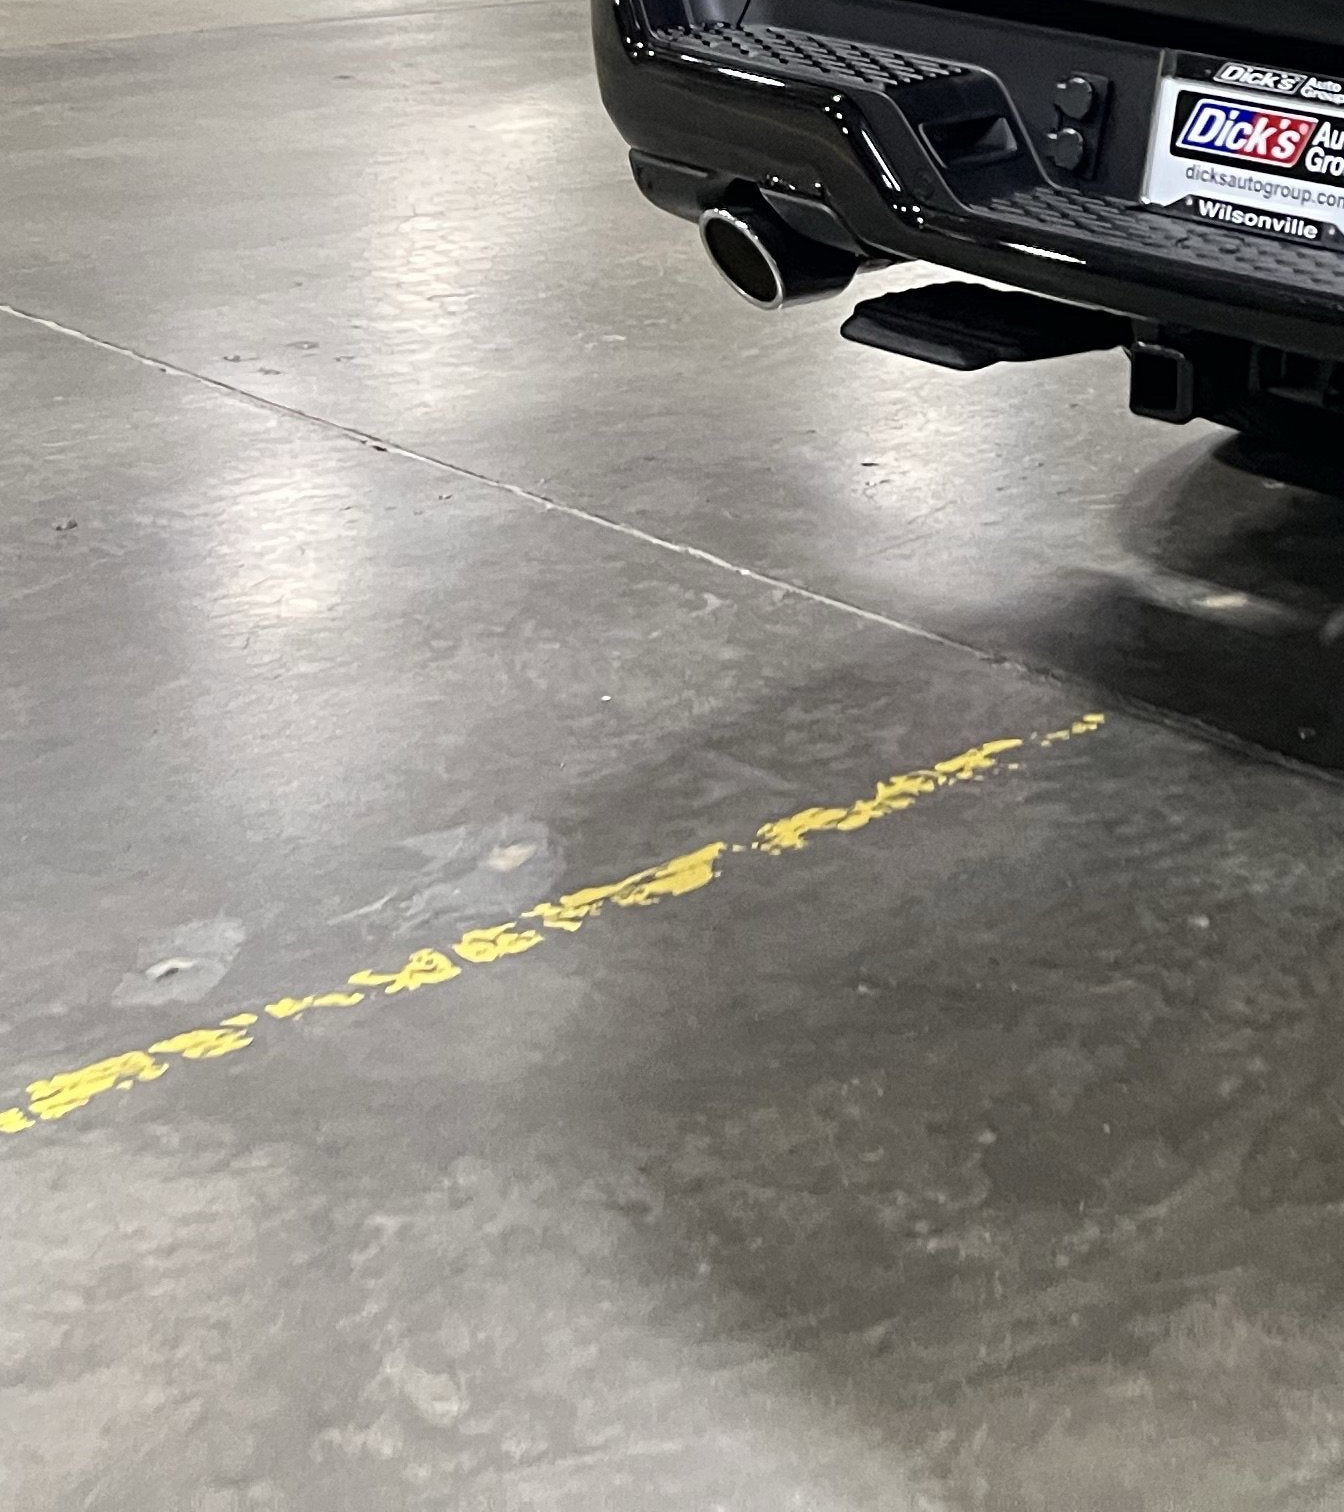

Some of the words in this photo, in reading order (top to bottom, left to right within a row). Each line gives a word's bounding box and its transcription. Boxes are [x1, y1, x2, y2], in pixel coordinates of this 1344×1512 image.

[1220, 65, 1296, 90] Dick's
[1303, 77, 1342, 93] Auto
[1187, 106, 1301, 160] Dick's
[1199, 199, 1318, 240] Wilsonville
